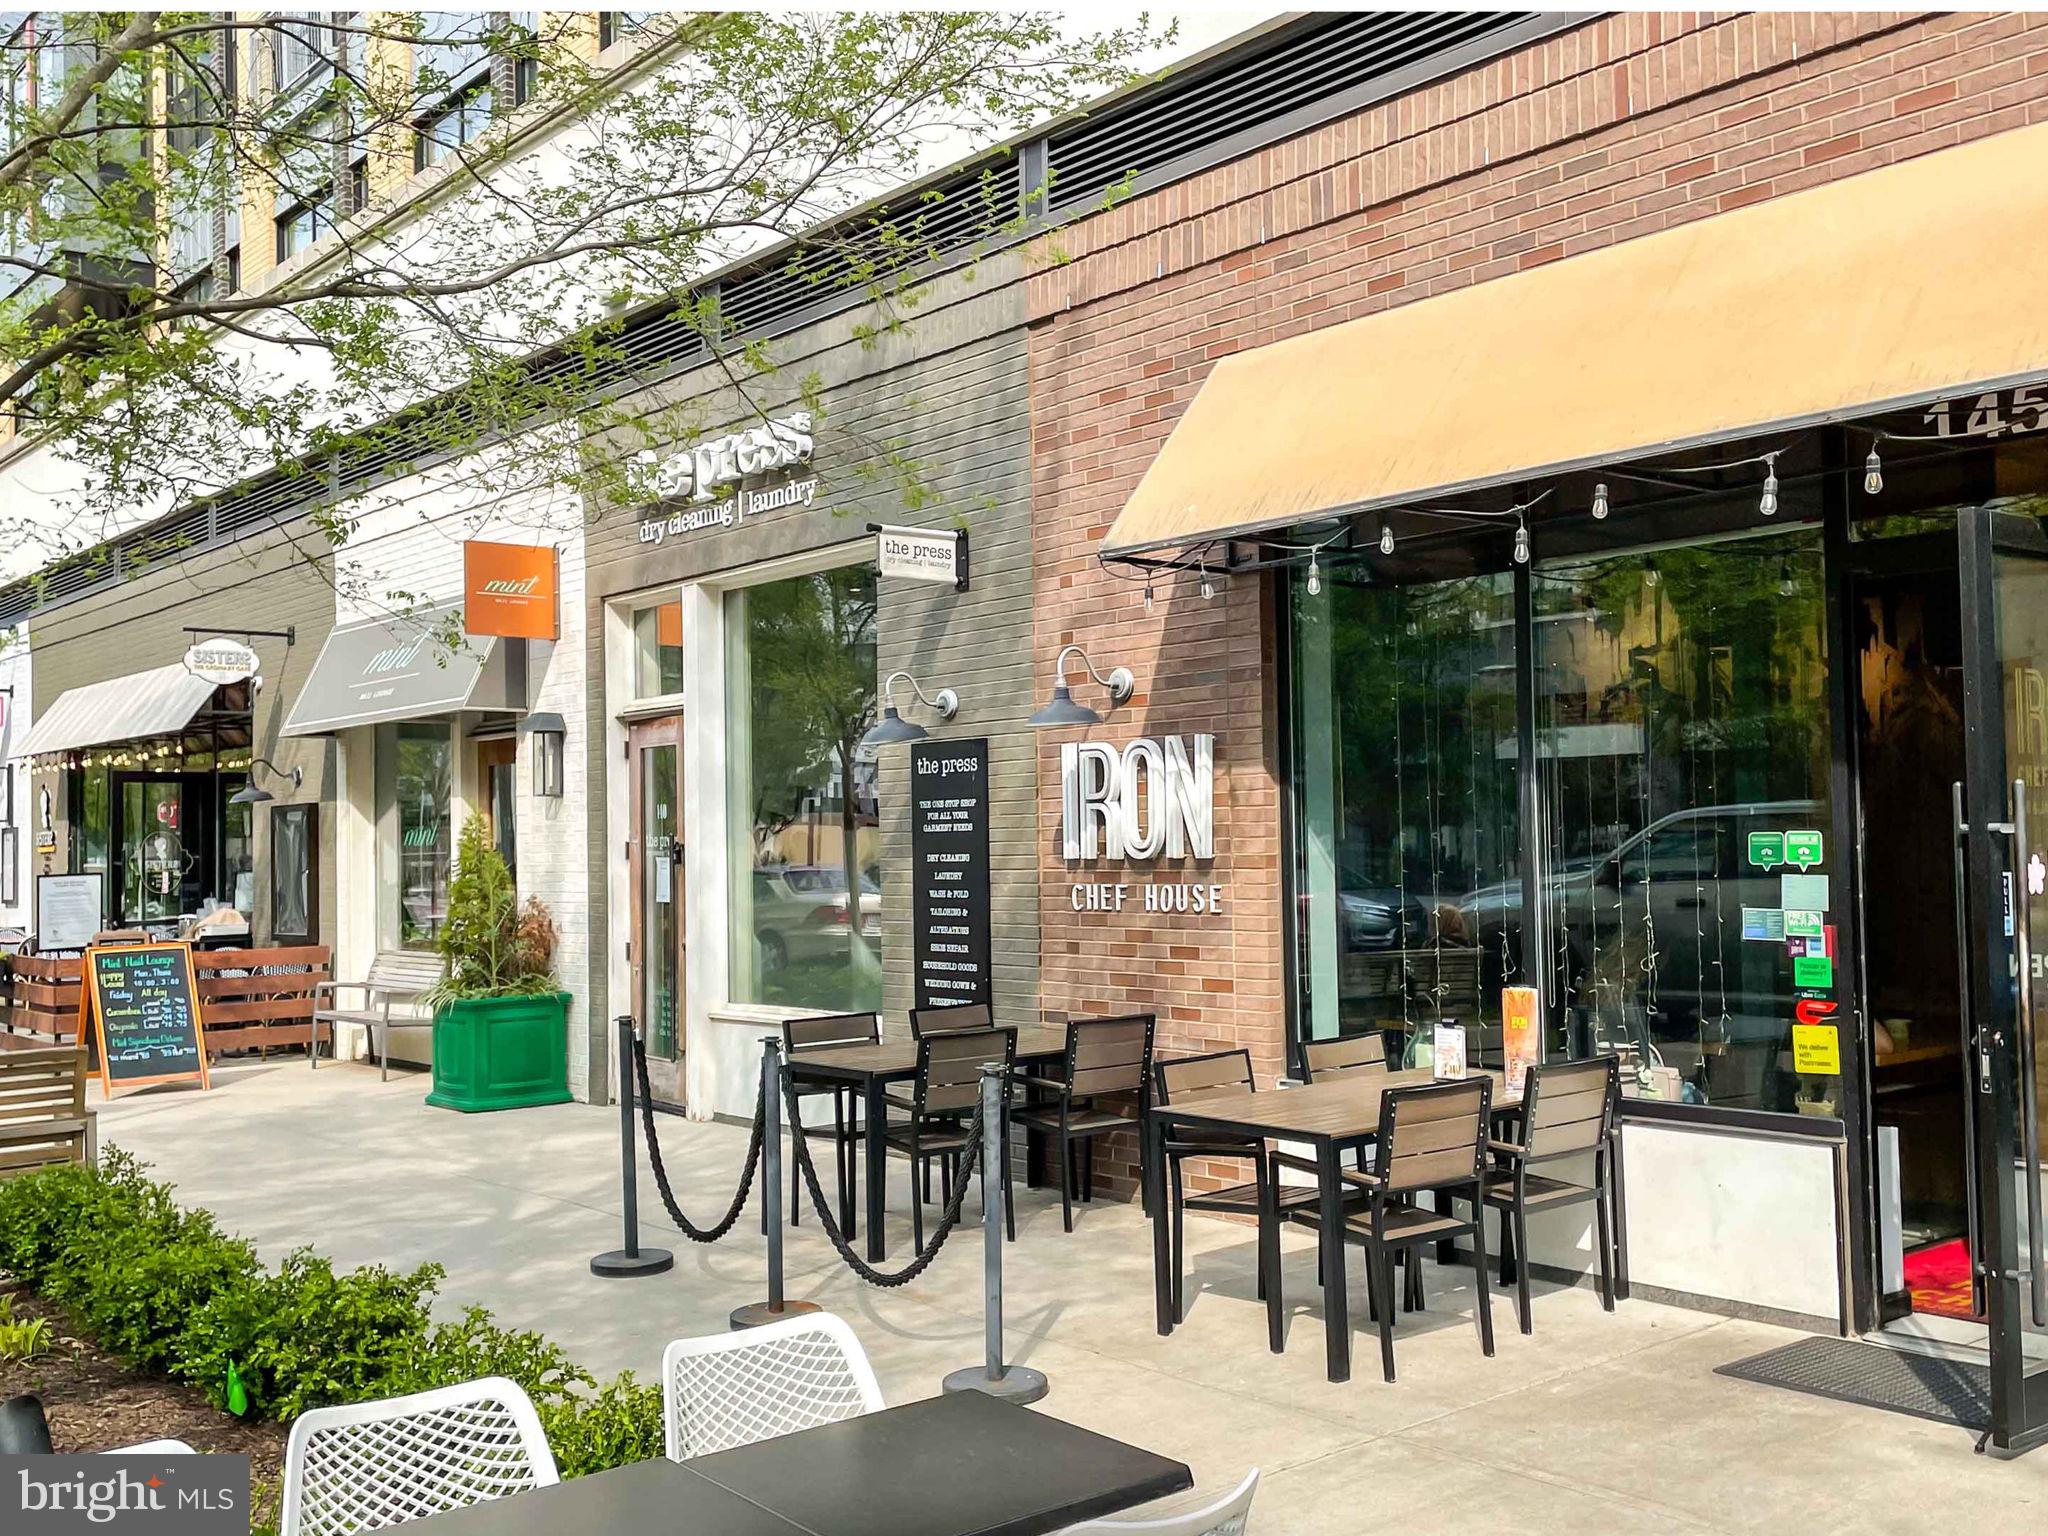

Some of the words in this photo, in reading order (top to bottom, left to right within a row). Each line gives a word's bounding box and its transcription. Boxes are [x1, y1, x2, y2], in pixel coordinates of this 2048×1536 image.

[639, 519, 667, 545] dry
[668, 499, 734, 536] cleaning
[747, 479, 818, 516] laundry
[885, 540, 909, 555] the
[912, 544, 952, 560] press
[484, 575, 541, 595] mint
[362, 624, 435, 676] mint
[917, 758, 939, 775] the
[941, 757, 978, 778] press
[1060, 733, 1215, 860] IRON
[919, 800, 931, 809] THE
[932, 799, 944, 808] ONE
[945, 799, 960, 808] STOP
[960, 798, 976, 807] SHOP
[927, 812, 939, 820] FOR
[940, 811, 951, 820] ALL
[952, 811, 969, 819] YOUR
[923, 823, 953, 832] GARMENT
[953, 823, 973, 832] NEEDS
[927, 854, 939, 862] DRY
[940, 853, 970, 862] CLEANING
[934, 872, 962, 880] LAUNDRY
[929, 889, 946, 898] WASH
[953, 890, 969, 898] FOLD
[1071, 883, 1129, 912] CHEF
[1144, 883, 1223, 914] HOUSE
[930, 908, 961, 916] TAILORING
[153, 987, 167, 1000] day
